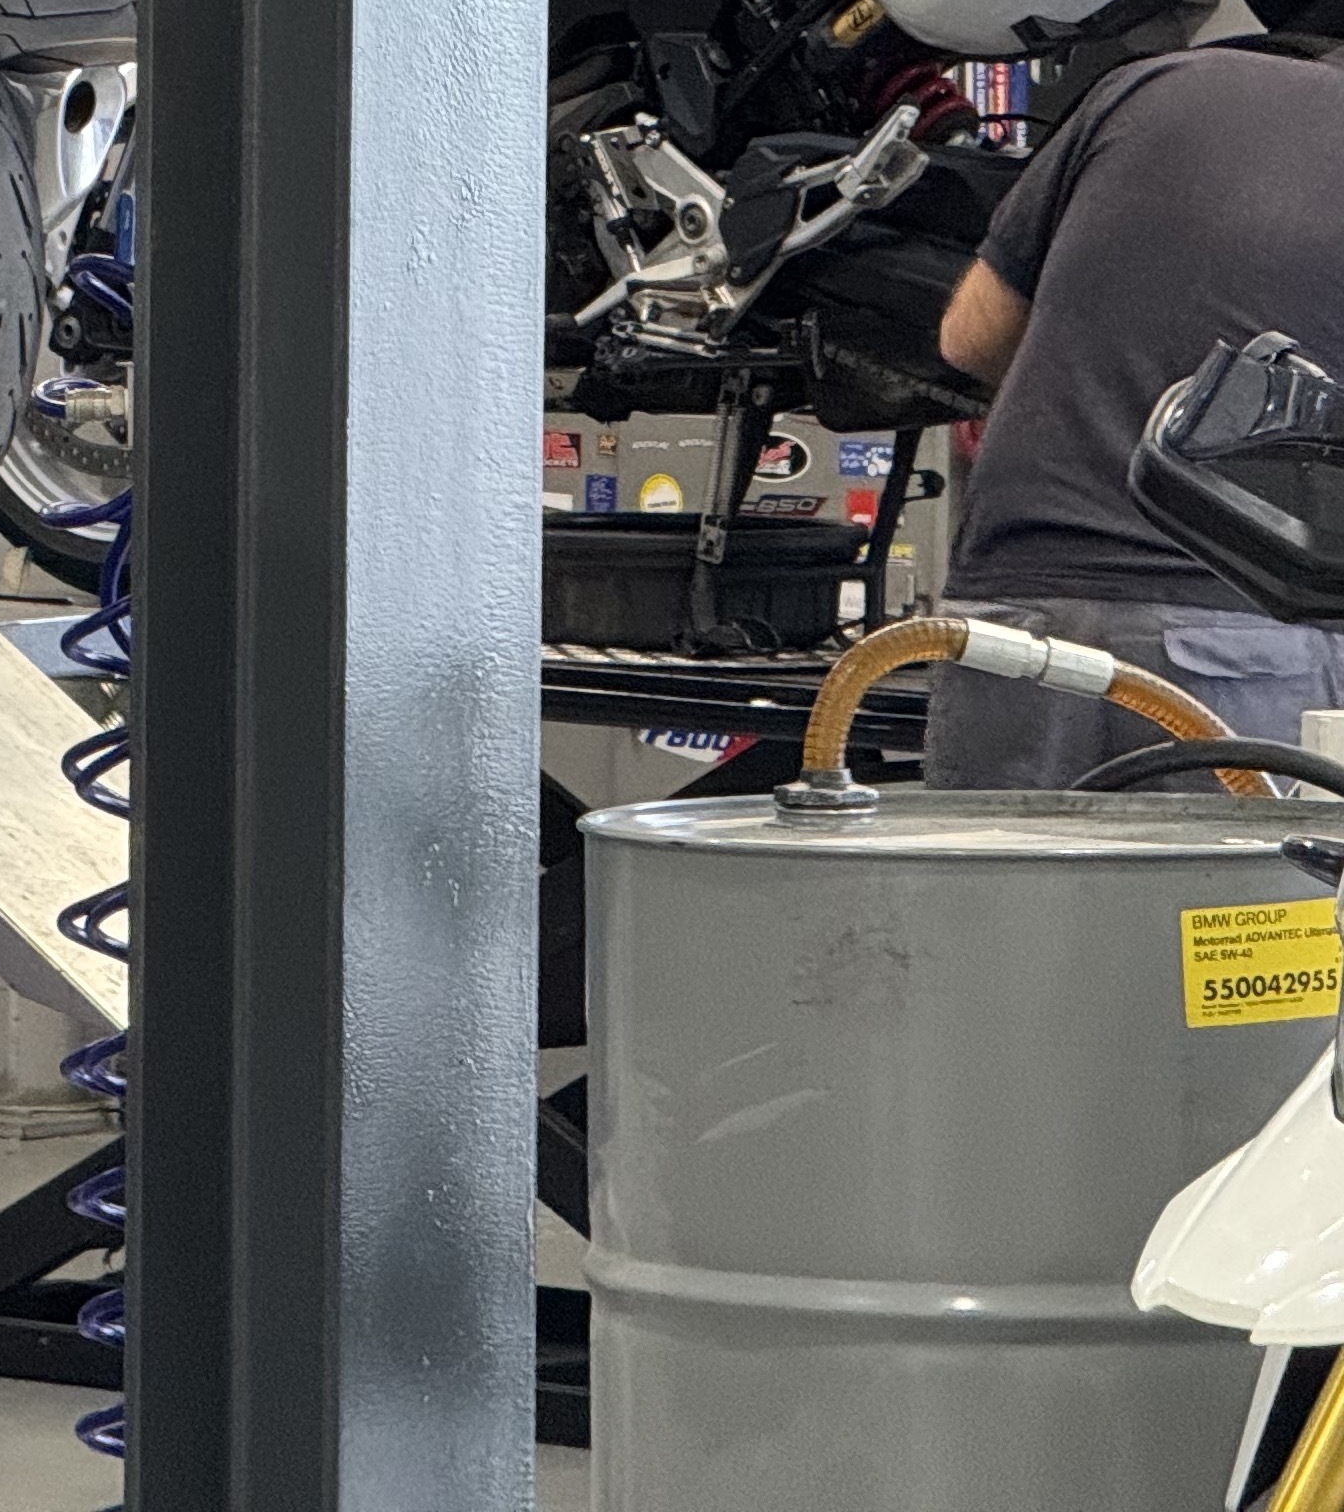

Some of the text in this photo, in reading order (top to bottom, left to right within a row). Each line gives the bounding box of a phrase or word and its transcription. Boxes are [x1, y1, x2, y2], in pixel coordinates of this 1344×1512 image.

[1192, 908, 1287, 930] BMW GROUP
[1193, 933, 1243, 947] Motorrad
[1244, 928, 1303, 943] ADVANTEC
[1193, 950, 1218, 962] SAE
[1202, 968, 1338, 1002] 550042955
